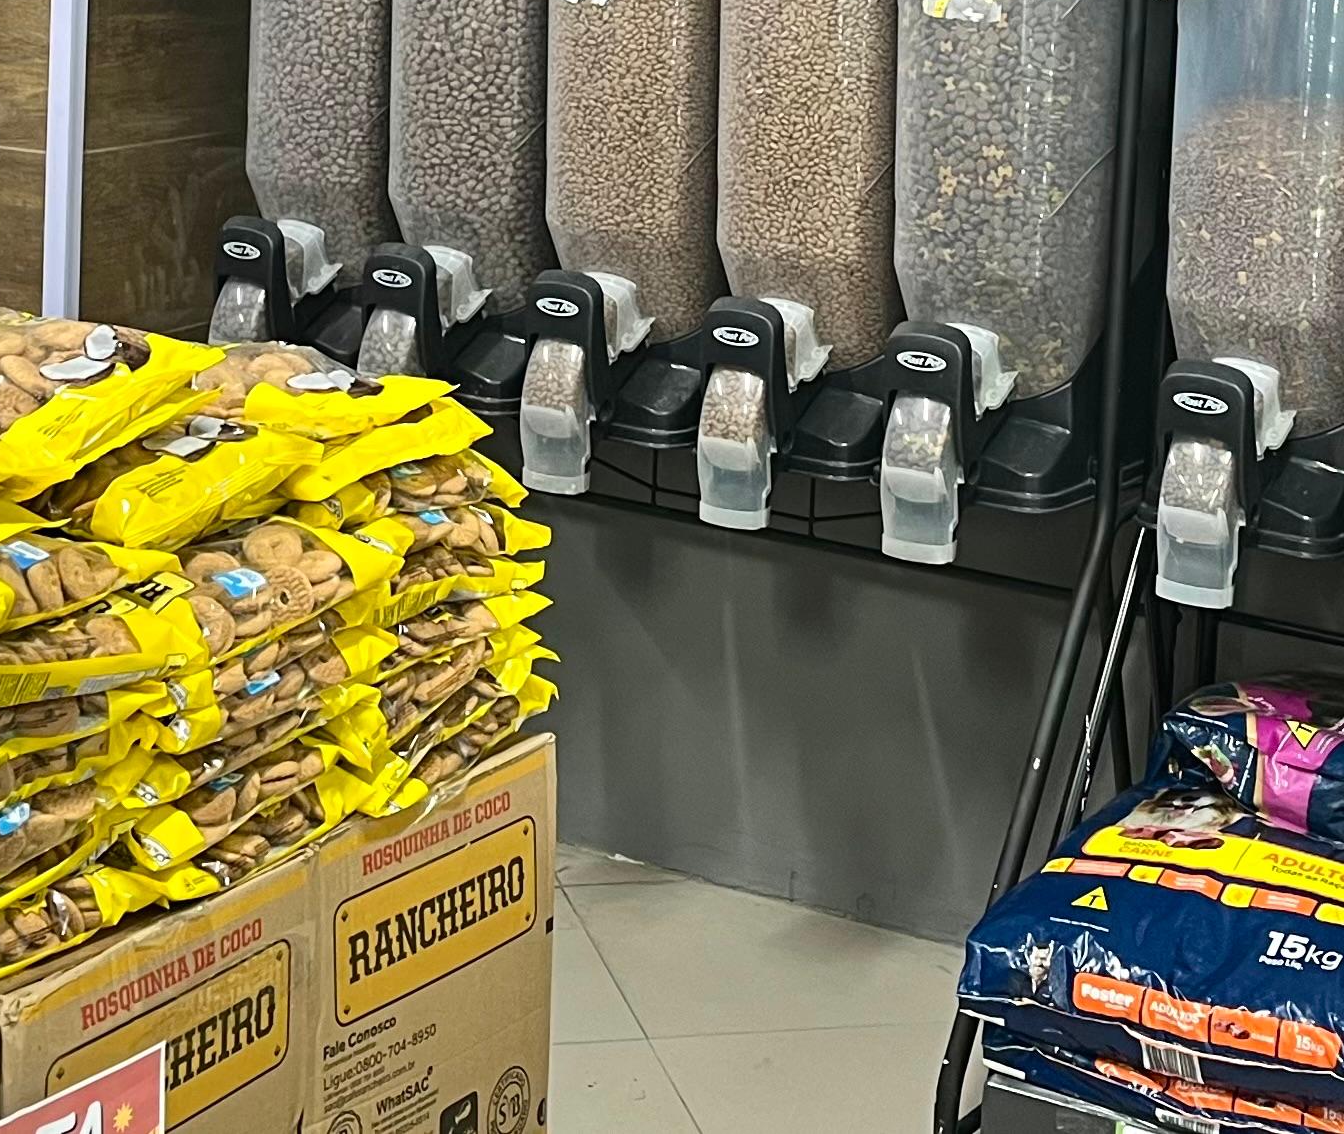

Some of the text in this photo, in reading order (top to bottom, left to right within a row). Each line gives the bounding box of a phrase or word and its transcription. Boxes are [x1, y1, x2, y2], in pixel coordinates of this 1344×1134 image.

[361, 790, 512, 876] ROSQUINHA DE COCO
[348, 855, 525, 985] RANCHEIRO
[1265, 930, 1344, 971] 15kg
[80, 917, 263, 1031] ROSQUINHA DE COCO
[1081, 982, 1134, 1007] Foster
[323, 1016, 397, 1061] Fale Conosco
[376, 1075, 430, 1117] WhatSAC
